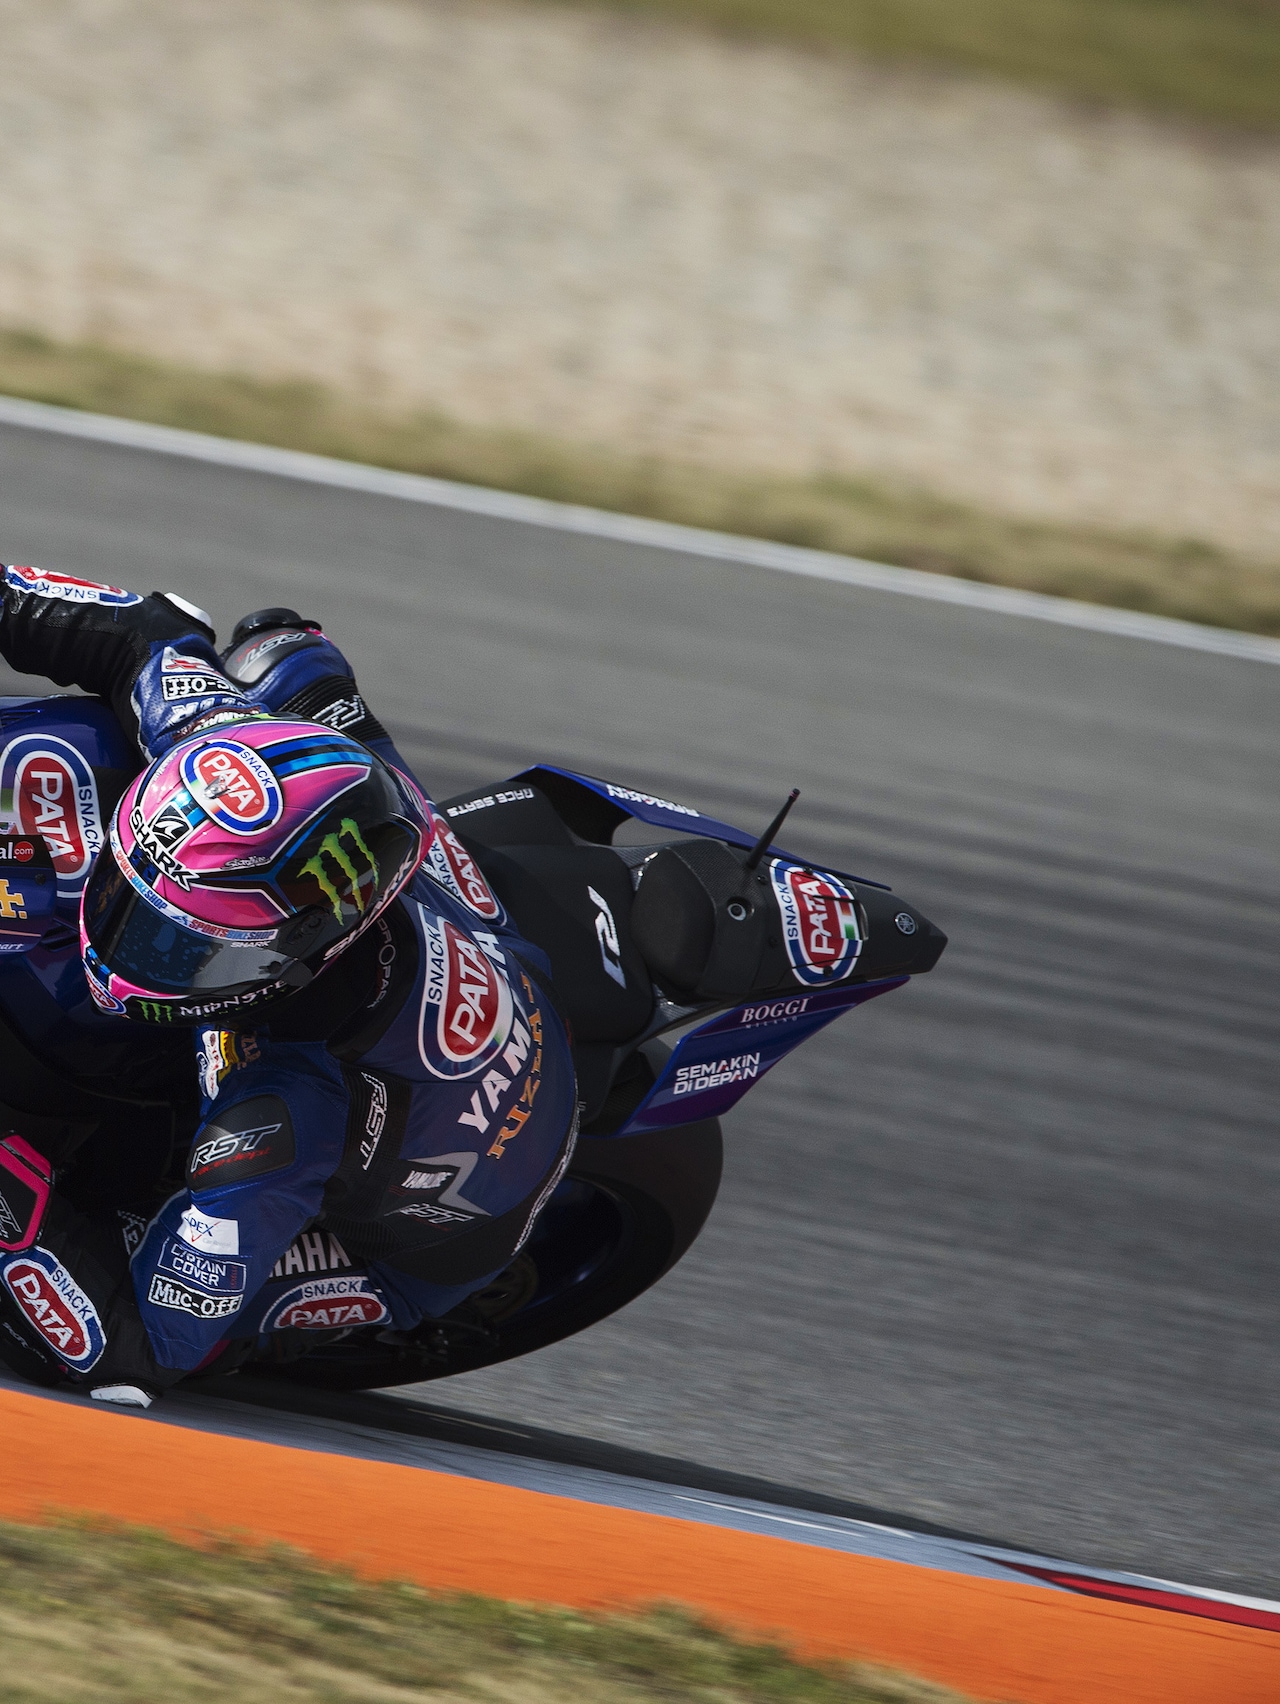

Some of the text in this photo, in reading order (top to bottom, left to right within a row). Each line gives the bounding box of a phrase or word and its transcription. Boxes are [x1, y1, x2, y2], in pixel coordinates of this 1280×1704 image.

[37, 581, 98, 599] SNACK
[203, 754, 257, 812] PATA
[240, 751, 273, 788] SNACK
[30, 771, 76, 858] PATA
[78, 788, 101, 853] SNACK
[447, 787, 535, 818] RACE SEATS
[129, 810, 199, 890] SHARK
[431, 843, 461, 897] SNACK
[444, 831, 492, 904] PATA
[775, 884, 798, 938] SNACK
[799, 881, 835, 955] PATA
[230, 940, 272, 948] SHARK
[428, 924, 445, 1003] SNACK
[179, 979, 288, 1017] MONSTE
[448, 938, 490, 1046] PATA
[740, 998, 810, 1023] BOGGI
[694, 1066, 759, 1091] DEPAN
[189, 1122, 283, 1173] RST
[52, 1269, 94, 1321] SNACK
[153, 1280, 239, 1316] Muc-Off
[172, 1258, 220, 1287] COVER
[303, 1280, 361, 1298] SNACK
[11, 1272, 75, 1350] PATA
[290, 1304, 367, 1326] PATA
